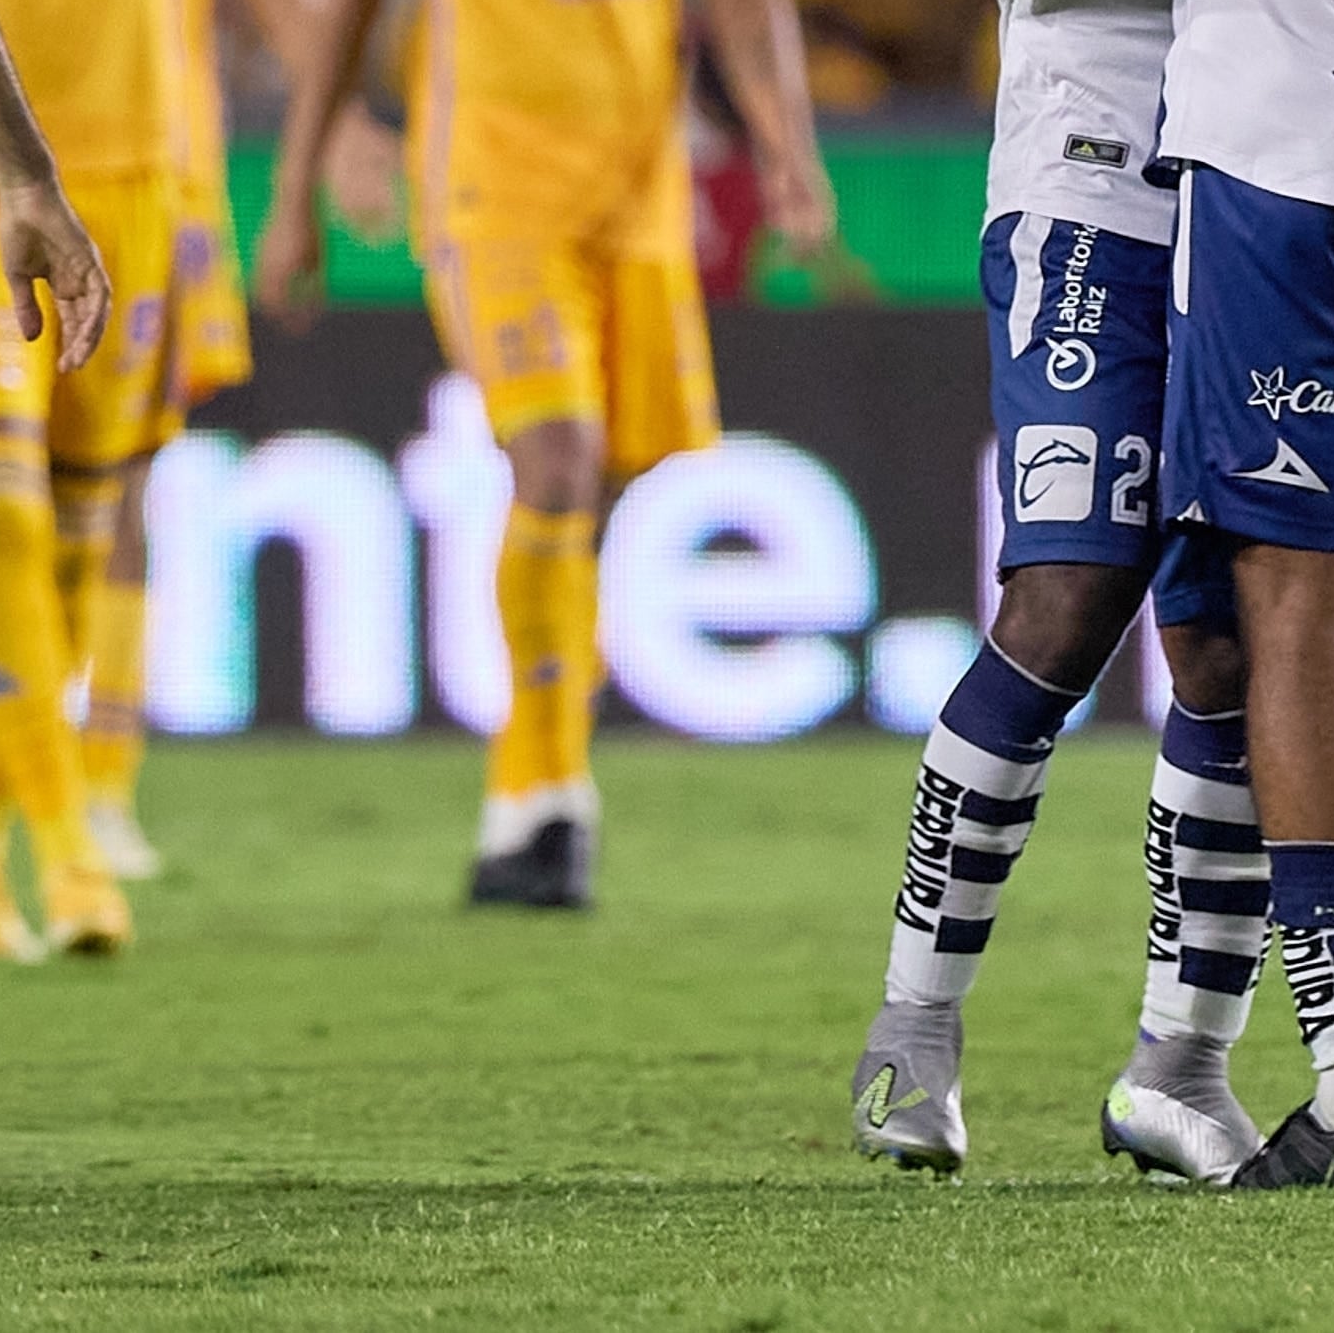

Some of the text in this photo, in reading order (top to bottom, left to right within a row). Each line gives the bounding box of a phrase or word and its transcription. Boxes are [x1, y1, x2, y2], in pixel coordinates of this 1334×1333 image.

[1078, 286, 1107, 334] Ruiz
[895, 763, 966, 934] PERDURA
[1144, 797, 1183, 963] PERDURA
